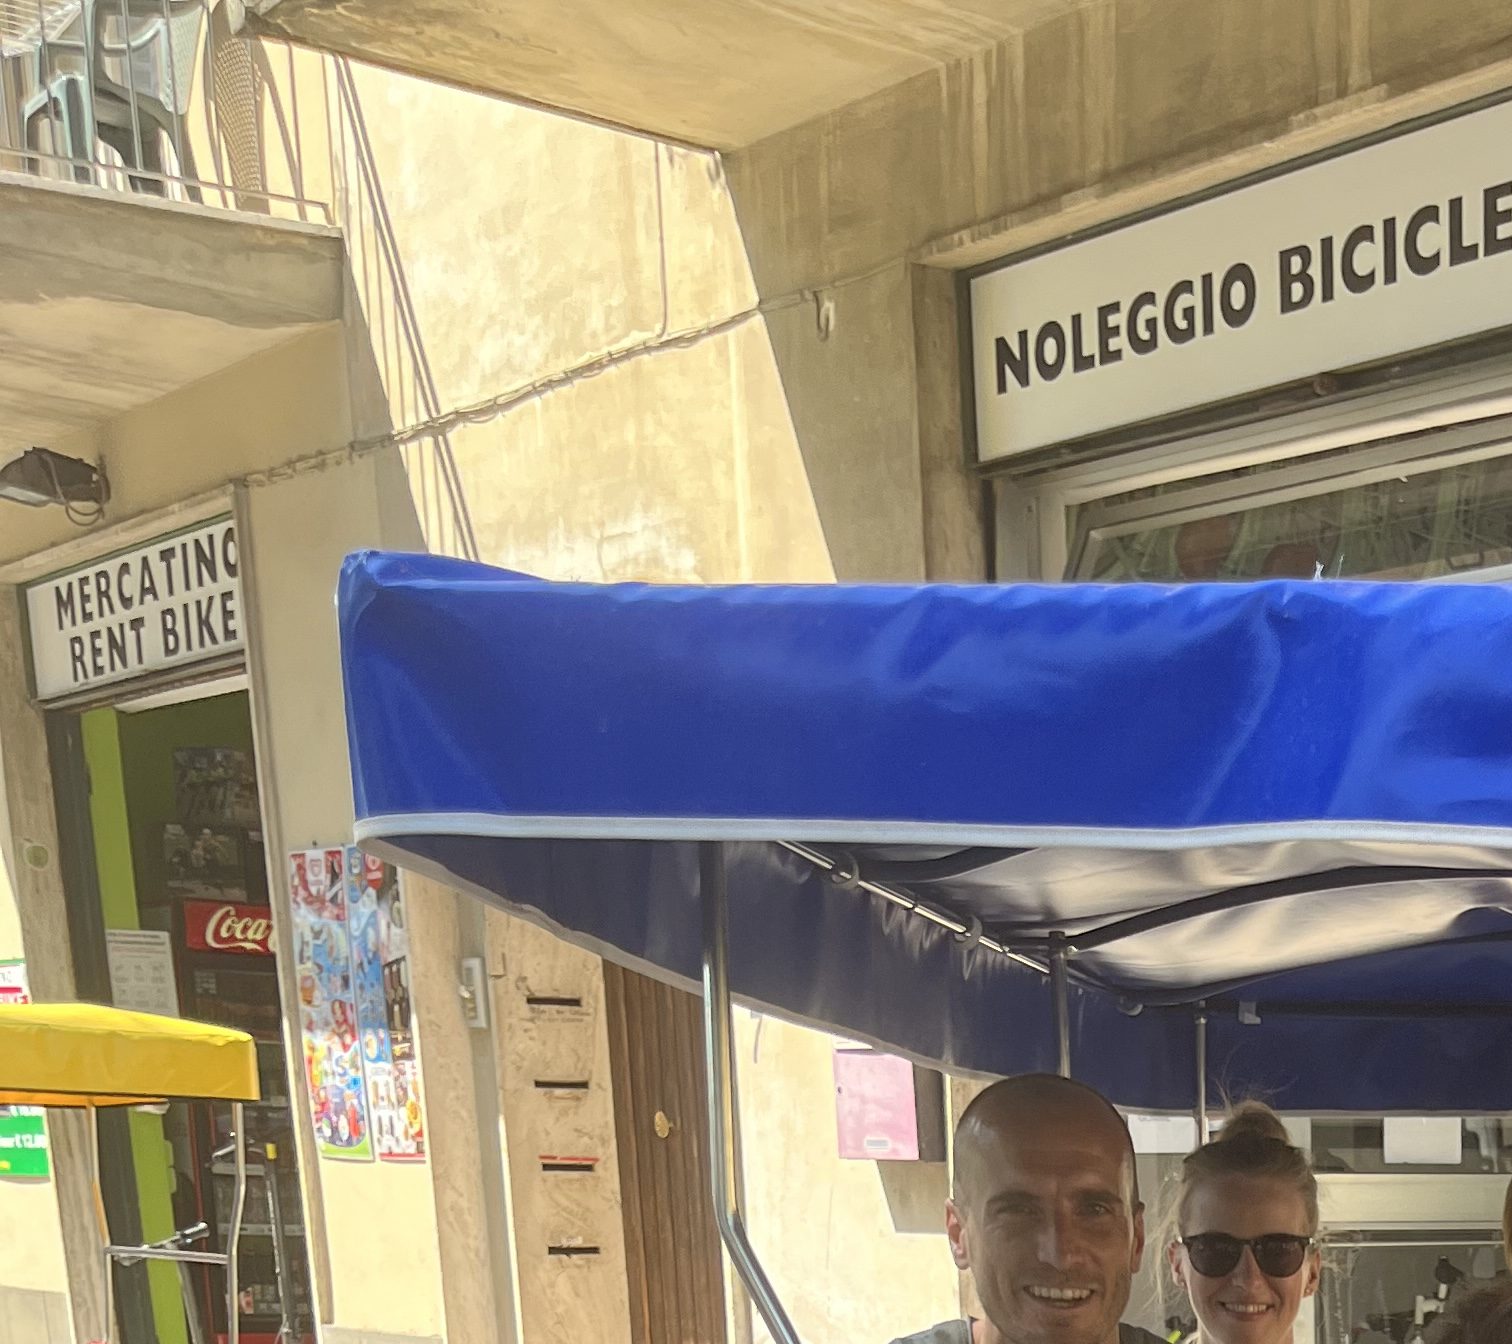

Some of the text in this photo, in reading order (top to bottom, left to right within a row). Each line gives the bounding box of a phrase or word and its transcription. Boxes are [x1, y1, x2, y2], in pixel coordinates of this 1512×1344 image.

[995, 262, 1256, 395] NOLEGGIO
[55, 527, 238, 630] MERCATINO
[69, 590, 238, 682] RENT BIKE
